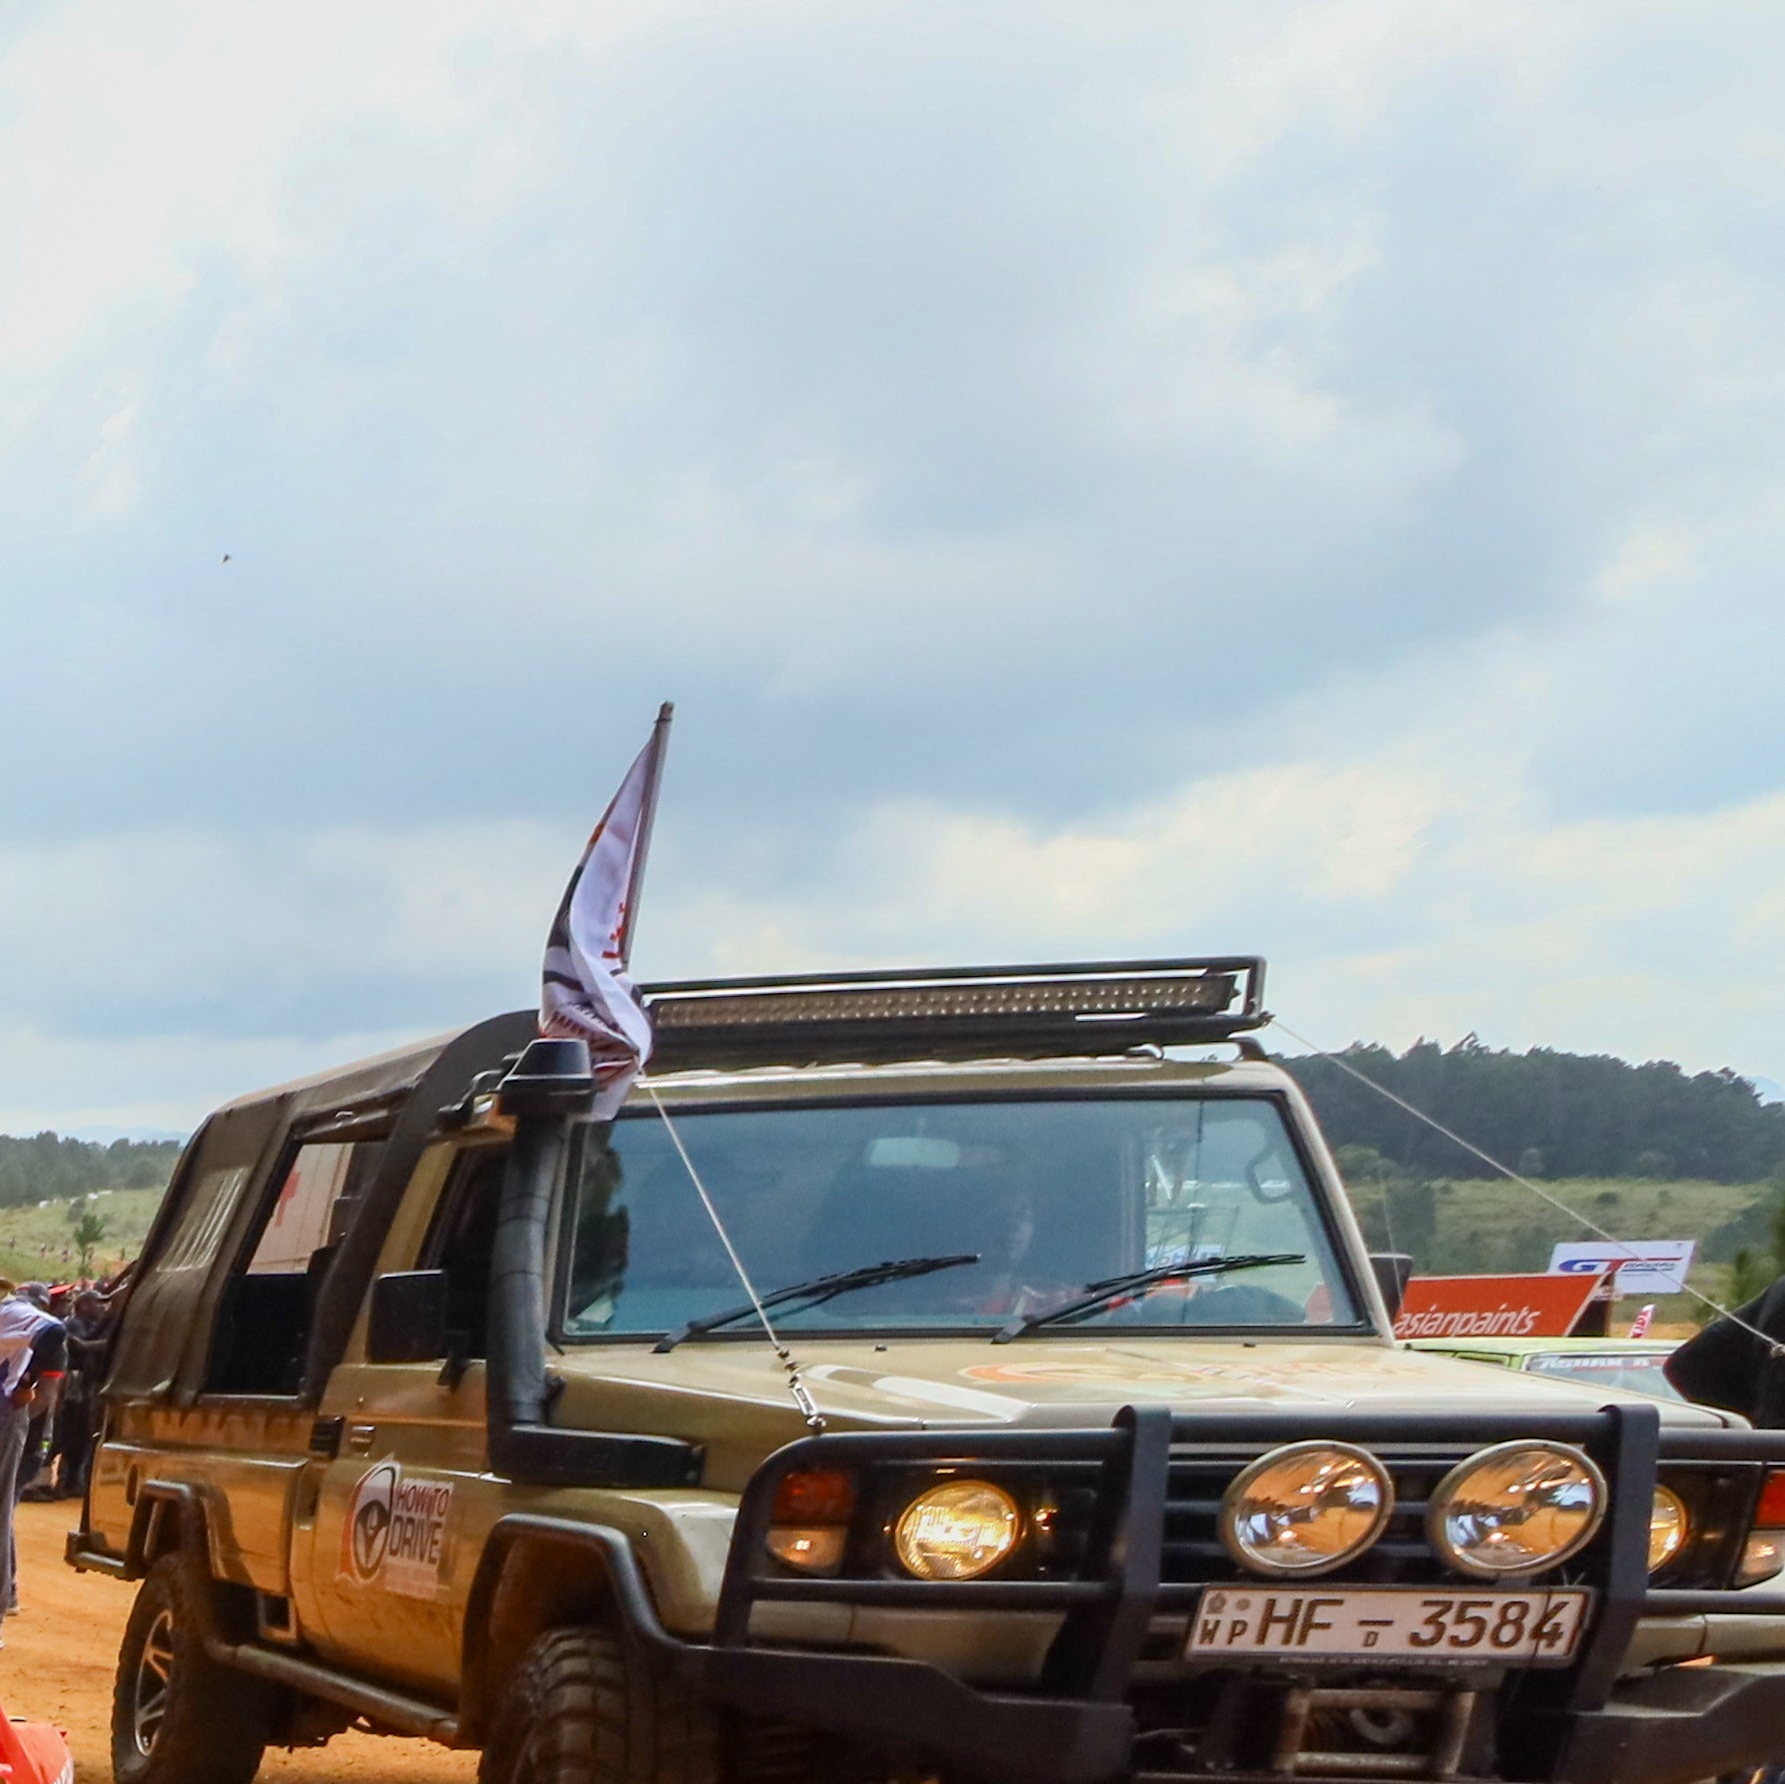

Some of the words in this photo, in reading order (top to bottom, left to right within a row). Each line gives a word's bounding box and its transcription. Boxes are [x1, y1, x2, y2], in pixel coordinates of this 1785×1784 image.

[1394, 1302, 1541, 1337] asianpaints
[395, 1483, 430, 1516] HOW
[431, 1487, 450, 1518] TO
[388, 1516, 443, 1565] DRIVE
[1255, 1598, 1344, 1647] HF
[1408, 1599, 1571, 1649] 3584
